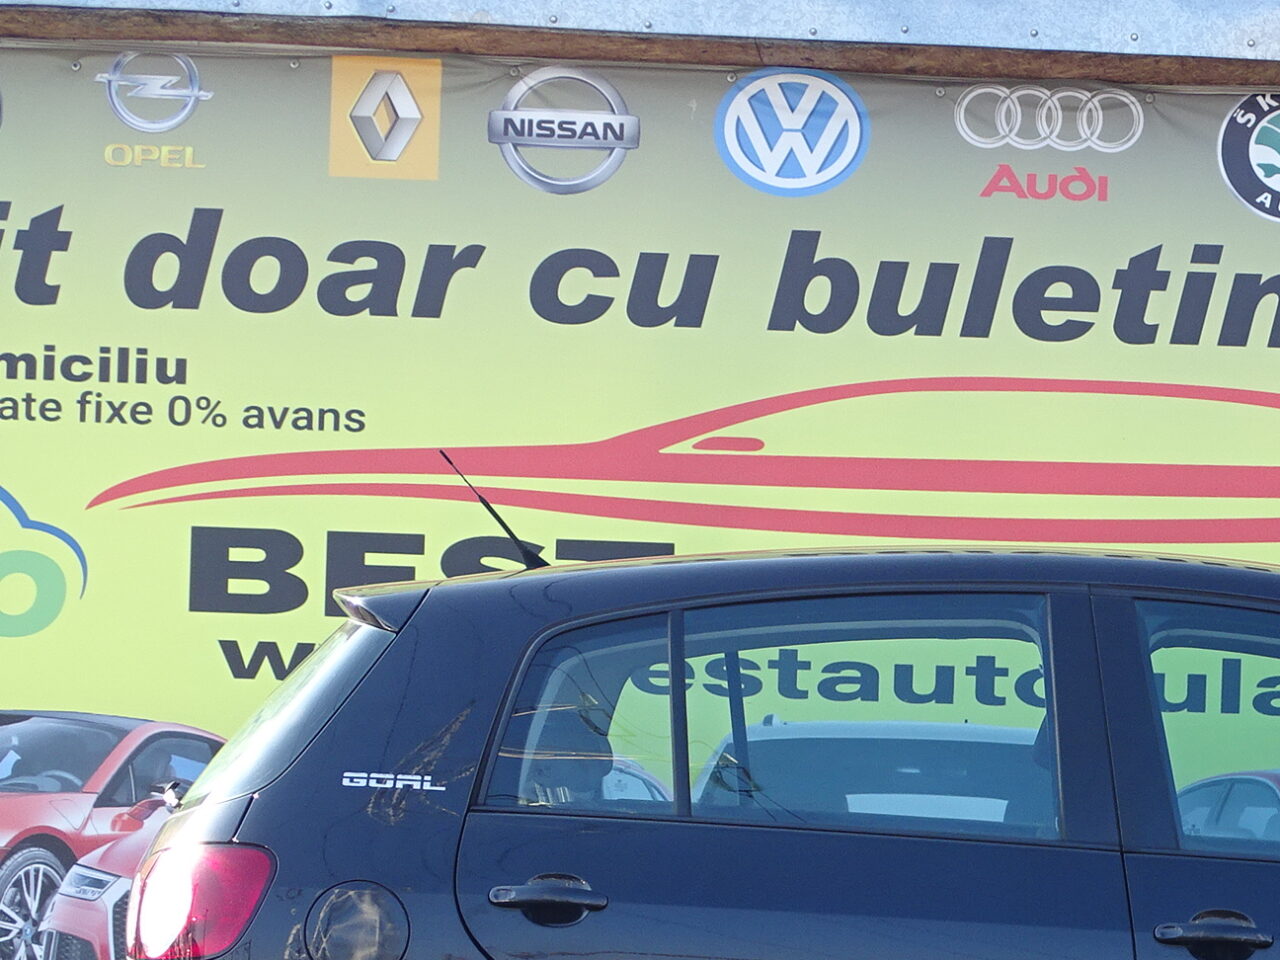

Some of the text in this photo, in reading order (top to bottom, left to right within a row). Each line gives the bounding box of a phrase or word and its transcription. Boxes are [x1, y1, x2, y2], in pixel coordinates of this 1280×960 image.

[502, 117, 625, 143] NISSAN
[104, 143, 206, 169] OPEL
[980, 164, 1108, 201] Audi
[124, 208, 486, 318] doar
[529, 248, 719, 329] cu
[0, 344, 188, 385] miciliu
[76, 390, 153, 425] fixe
[166, 395, 228, 428] 0%
[242, 403, 367, 433] avans
[188, 526, 675, 616] BE
[342, 771, 446, 791] GOAL
